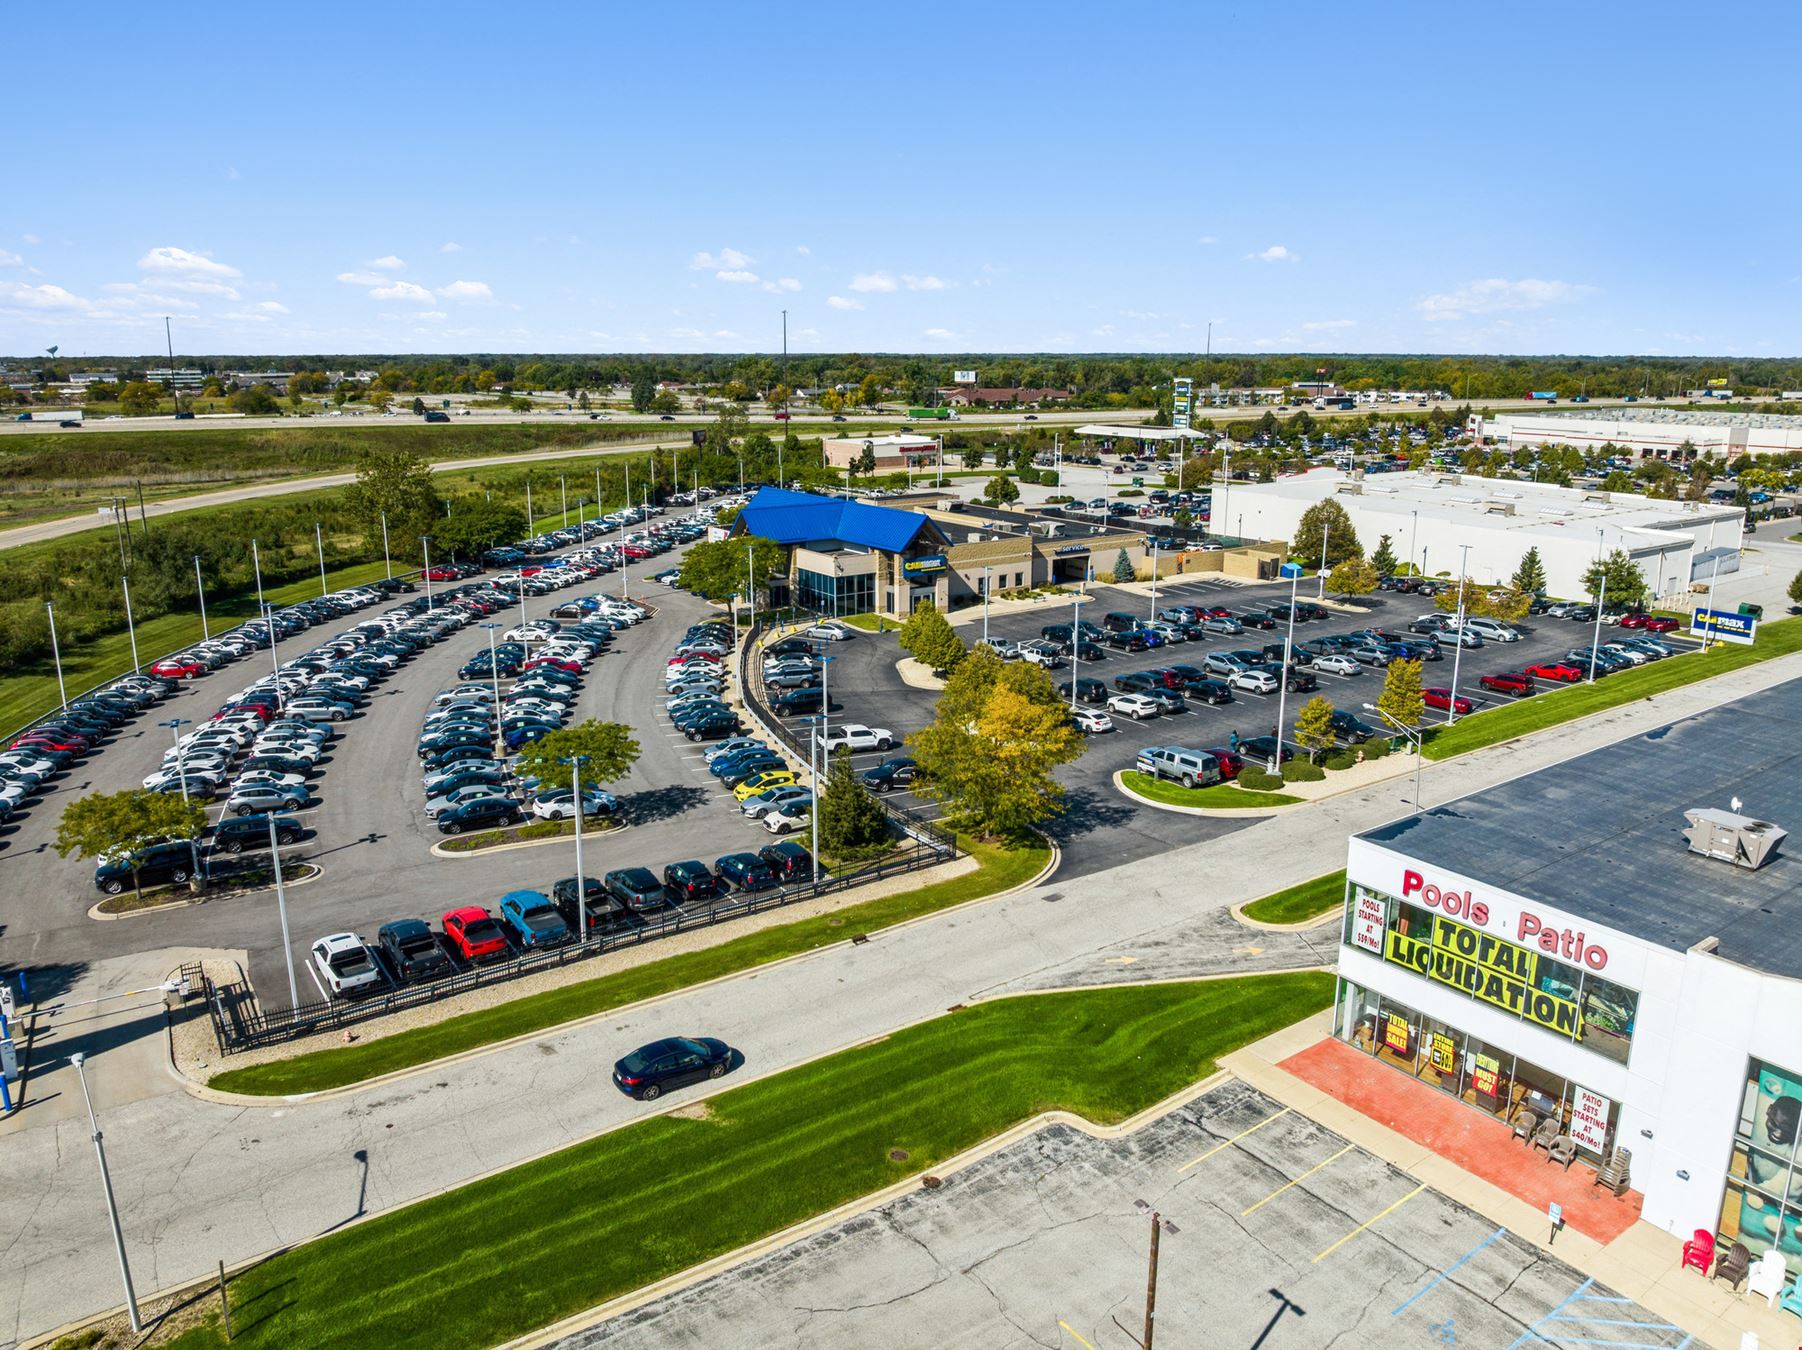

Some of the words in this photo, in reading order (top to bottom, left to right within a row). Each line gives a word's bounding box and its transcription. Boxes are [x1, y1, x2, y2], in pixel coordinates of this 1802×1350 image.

[1363, 899, 1379, 912] POOLS
[1359, 909, 1382, 926] STARTING
[1402, 869, 1489, 926] Pools
[1517, 911, 1608, 970] Patio
[1366, 924, 1373, 934] AT
[1438, 919, 1532, 981] TOTAL
[1392, 935, 1579, 1034] LIQUIDATION
[1476, 1068, 1496, 1084] MUST
[1478, 1080, 1492, 1092] GO!
[1582, 1093, 1601, 1107] PATIO
[1583, 1104, 1598, 1116] SETS
[1573, 1109, 1605, 1130] STARTING
[1583, 1124, 1592, 1134] AT
